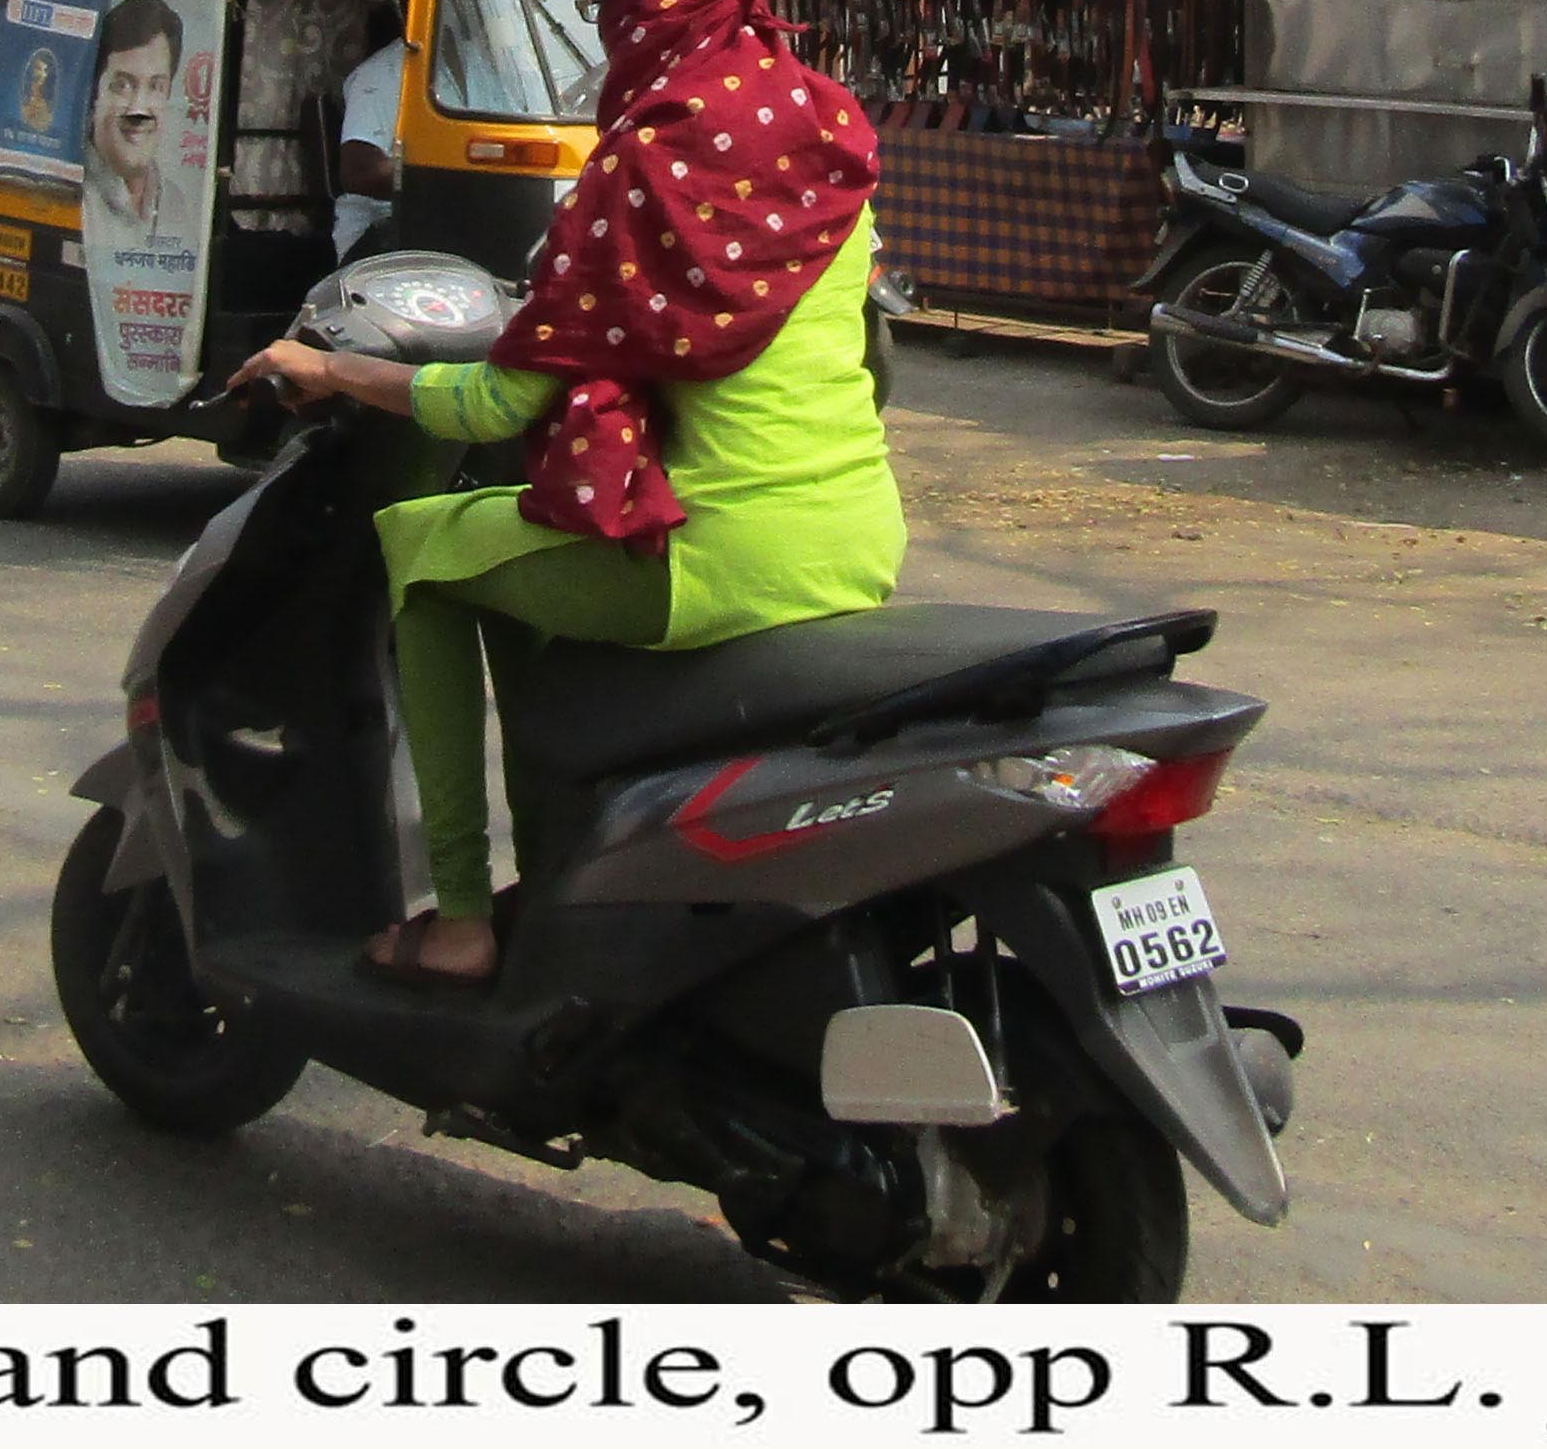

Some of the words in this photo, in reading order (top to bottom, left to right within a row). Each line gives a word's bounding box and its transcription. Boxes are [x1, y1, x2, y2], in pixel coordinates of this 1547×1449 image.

[1118, 905, 1146, 931] MH
[1146, 901, 1168, 924] 09
[1168, 894, 1191, 917] EN
[1114, 919, 1220, 977] 0562
